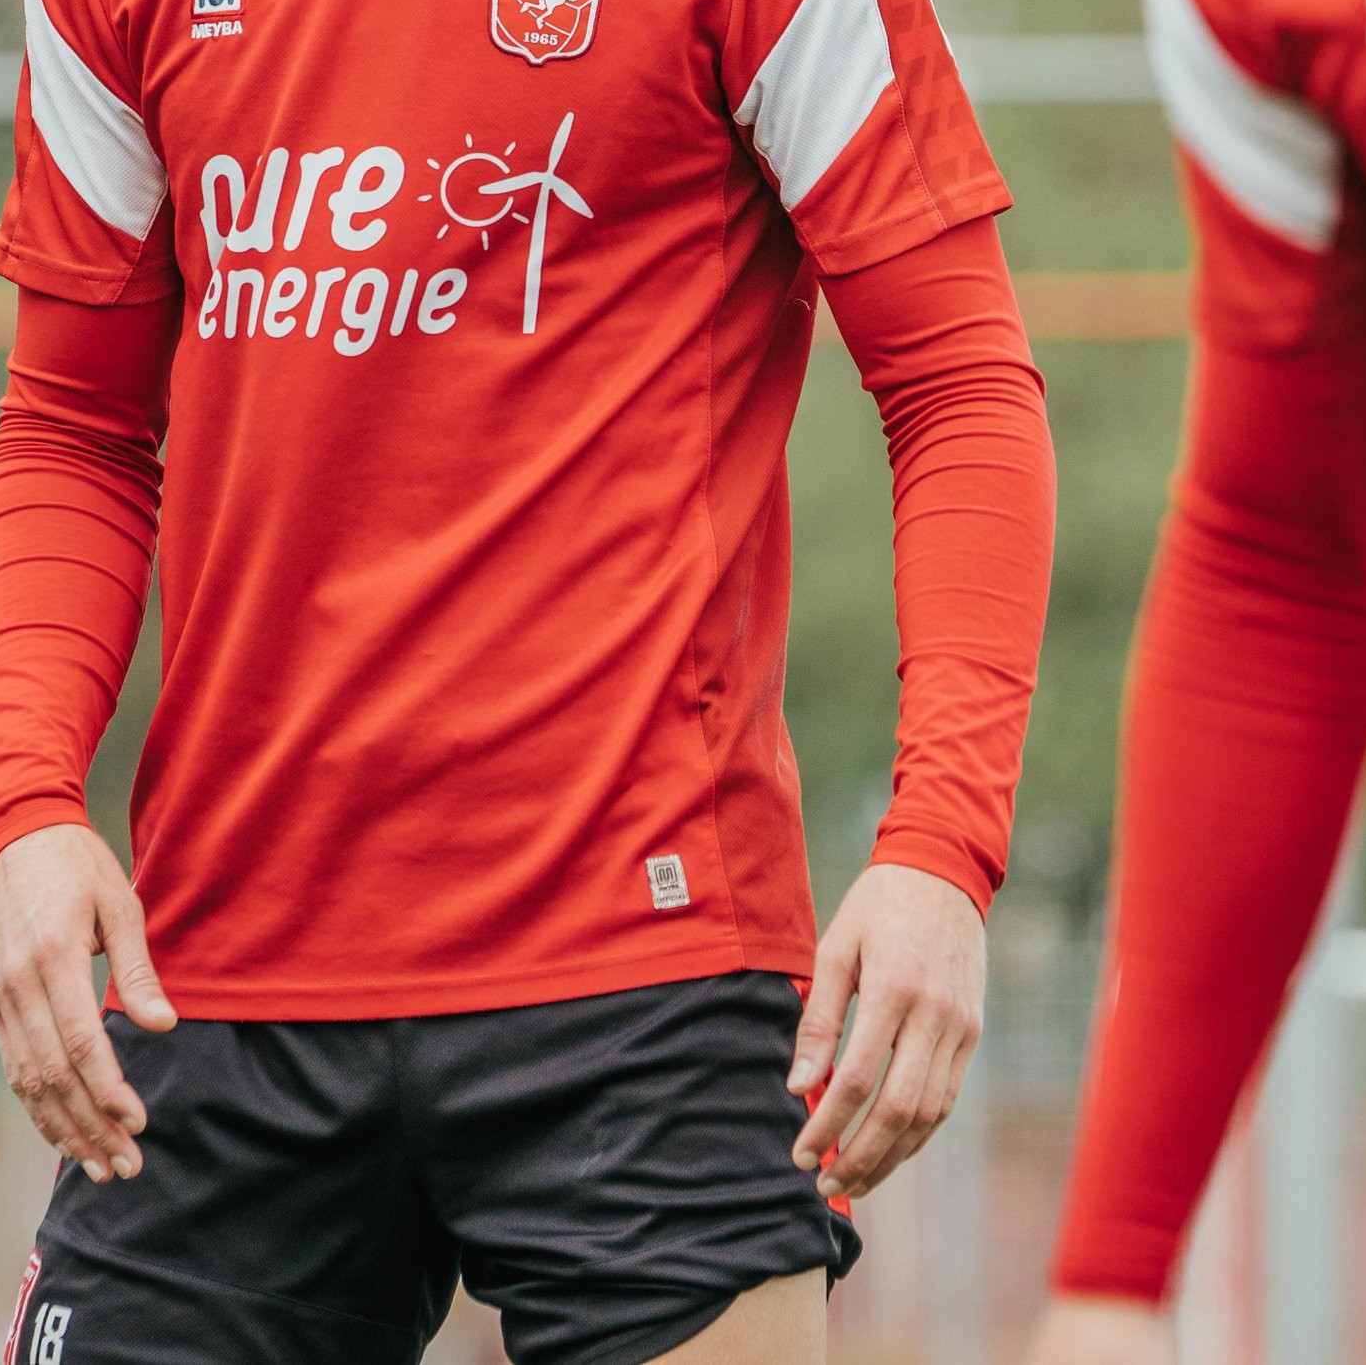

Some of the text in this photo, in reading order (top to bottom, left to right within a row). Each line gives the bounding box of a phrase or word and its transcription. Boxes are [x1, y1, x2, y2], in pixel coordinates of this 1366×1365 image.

[191, 20, 243, 39] MEYBA
[523, 32, 558, 45] 1965
[200, 145, 405, 271] pure
[198, 267, 468, 357] energie
[30, 1302, 72, 1365] 18
